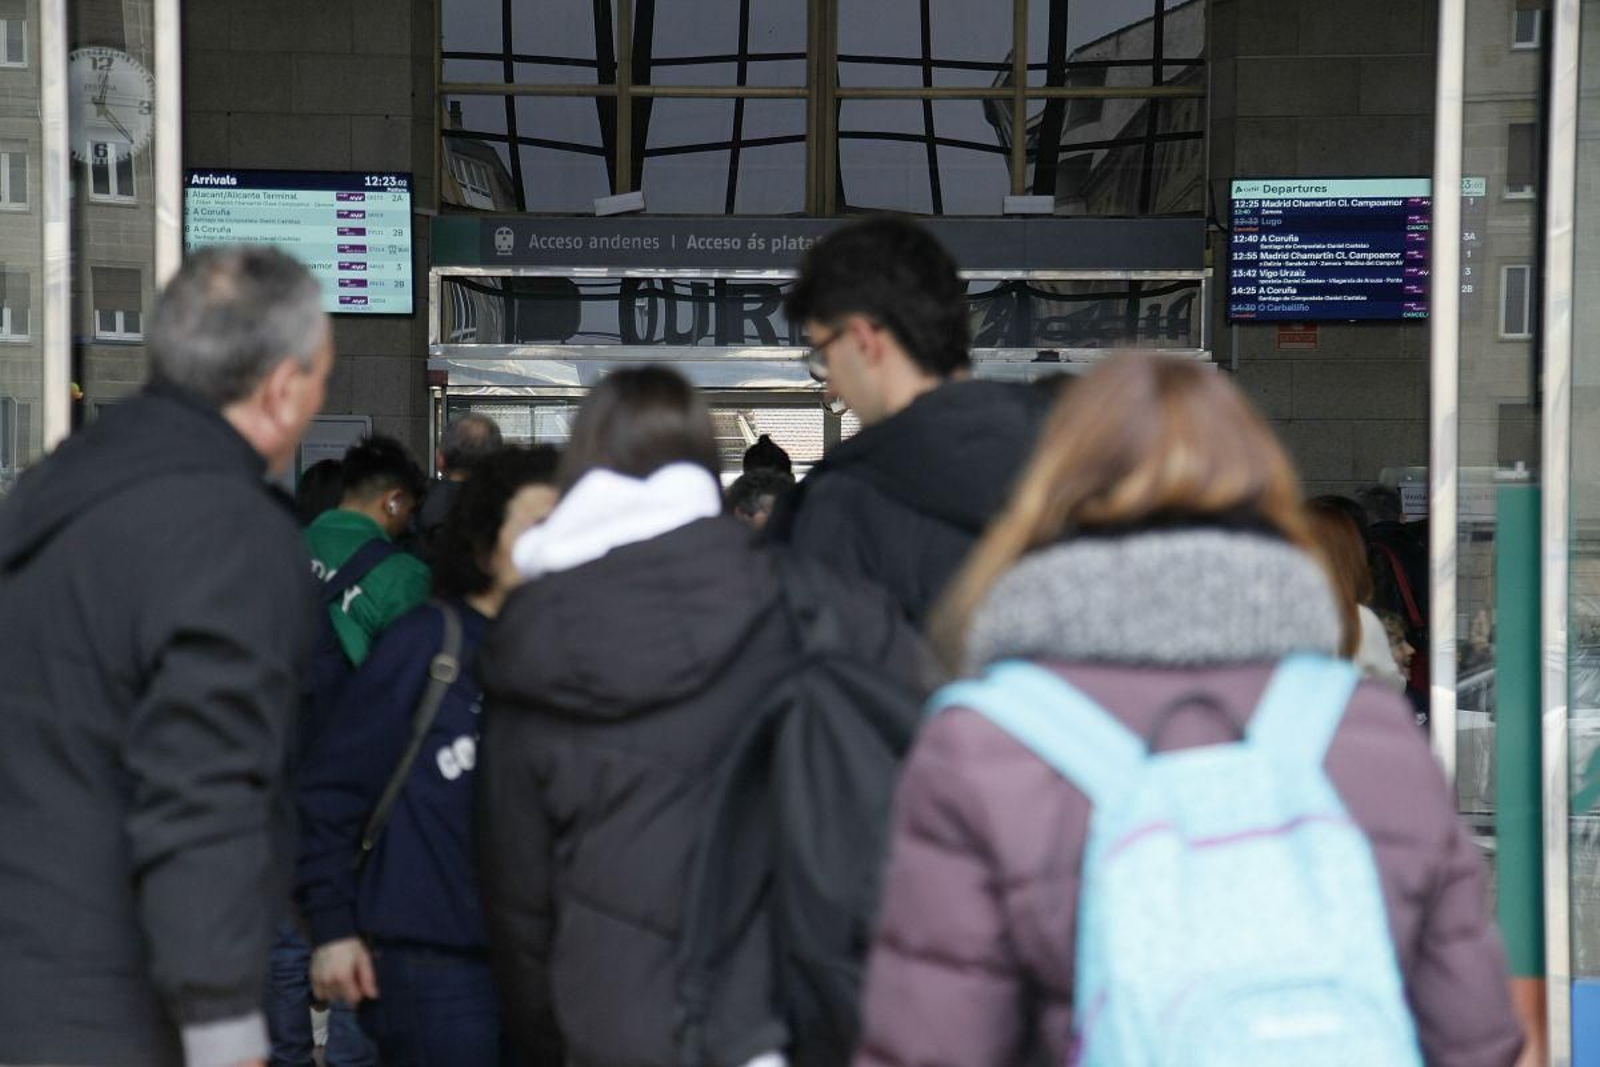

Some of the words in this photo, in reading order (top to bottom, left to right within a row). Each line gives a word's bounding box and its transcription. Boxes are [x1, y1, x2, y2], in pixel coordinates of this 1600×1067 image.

[94, 143, 108, 157] 6
[191, 174, 237, 185] Arrivals
[1263, 185, 1327, 195] Departures
[392, 194, 402, 202] 2A
[1234, 200, 1260, 208] 12:25
[1261, 199, 1291, 208] Madrid
[1350, 199, 1403, 209] Campoamor
[200, 208, 230, 216] Coruña
[1261, 218, 1282, 227] Lugo
[201, 225, 231, 233] Coruña
[392, 229, 404, 237] 2B
[1233, 235, 1259, 243] 12:40
[1268, 234, 1299, 242] Coruña
[1463, 232, 1476, 240] 3A
[528, 234, 583, 249] Acceso
[588, 234, 660, 249] andenes
[686, 234, 741, 250] Acceso
[747, 232, 766, 250] ás
[1233, 252, 1258, 260] 12:55
[1260, 252, 1289, 260] Madrid
[1349, 251, 1401, 261] Campoamor
[1232, 269, 1257, 278] 13:42
[1260, 269, 1278, 279] Vigo
[1465, 267, 1471, 275] 3
[1231, 287, 1257, 295] 14:25
[1267, 286, 1297, 294] Coruña
[1461, 284, 1473, 292] 2B
[1267, 303, 1310, 311] Carballiño
